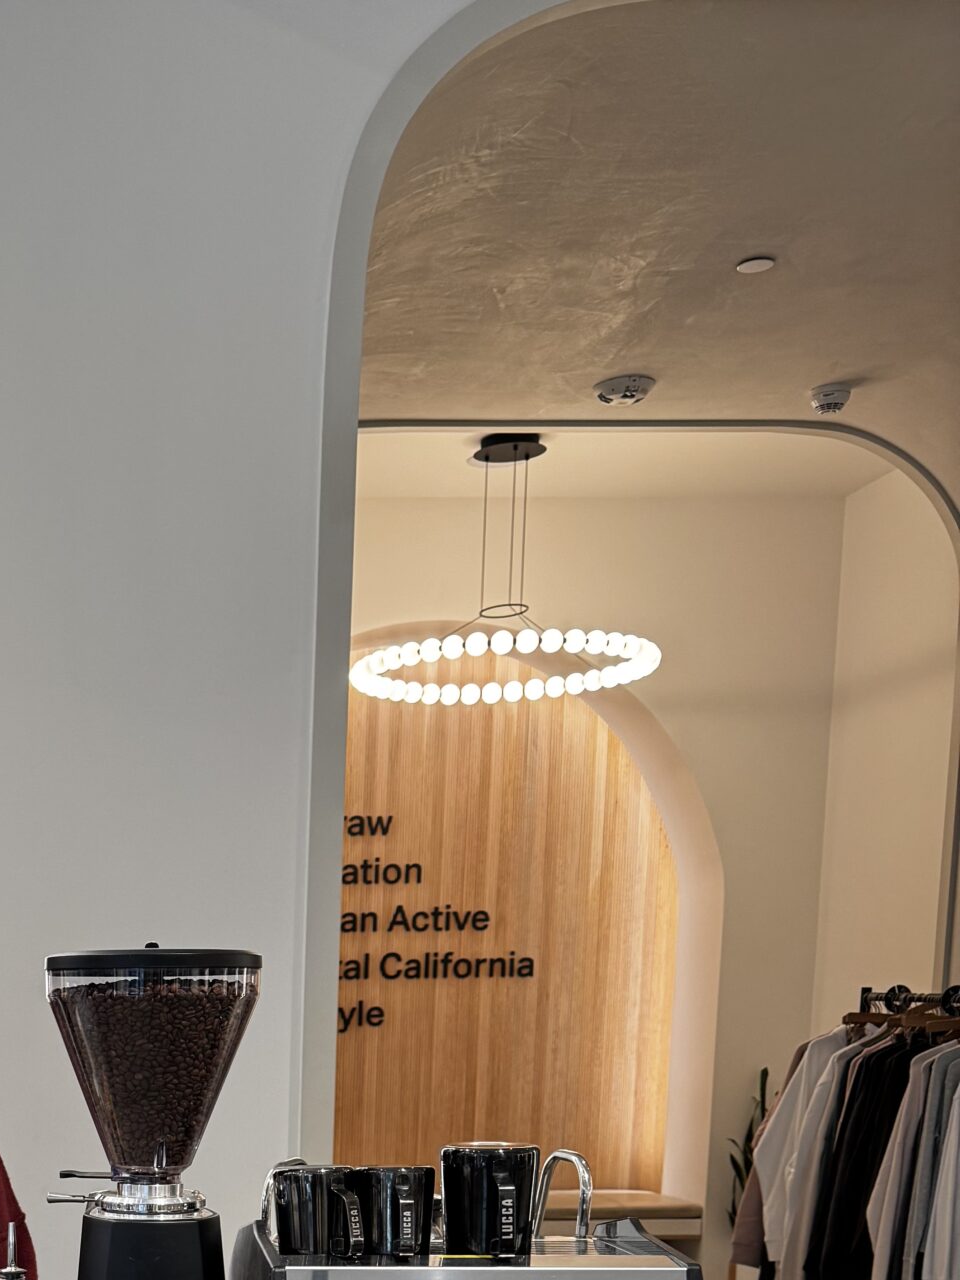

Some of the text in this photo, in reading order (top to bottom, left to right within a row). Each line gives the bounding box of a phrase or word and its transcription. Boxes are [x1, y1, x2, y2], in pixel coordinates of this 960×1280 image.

[344, 815, 393, 836] aw
[341, 857, 422, 885] ation
[340, 904, 490, 933] an Active
[379, 951, 534, 980] California
[350, 1209, 361, 1240] LUCCA
[403, 1211, 412, 1238] LUCCA
[501, 1198, 513, 1239] LUCCA
